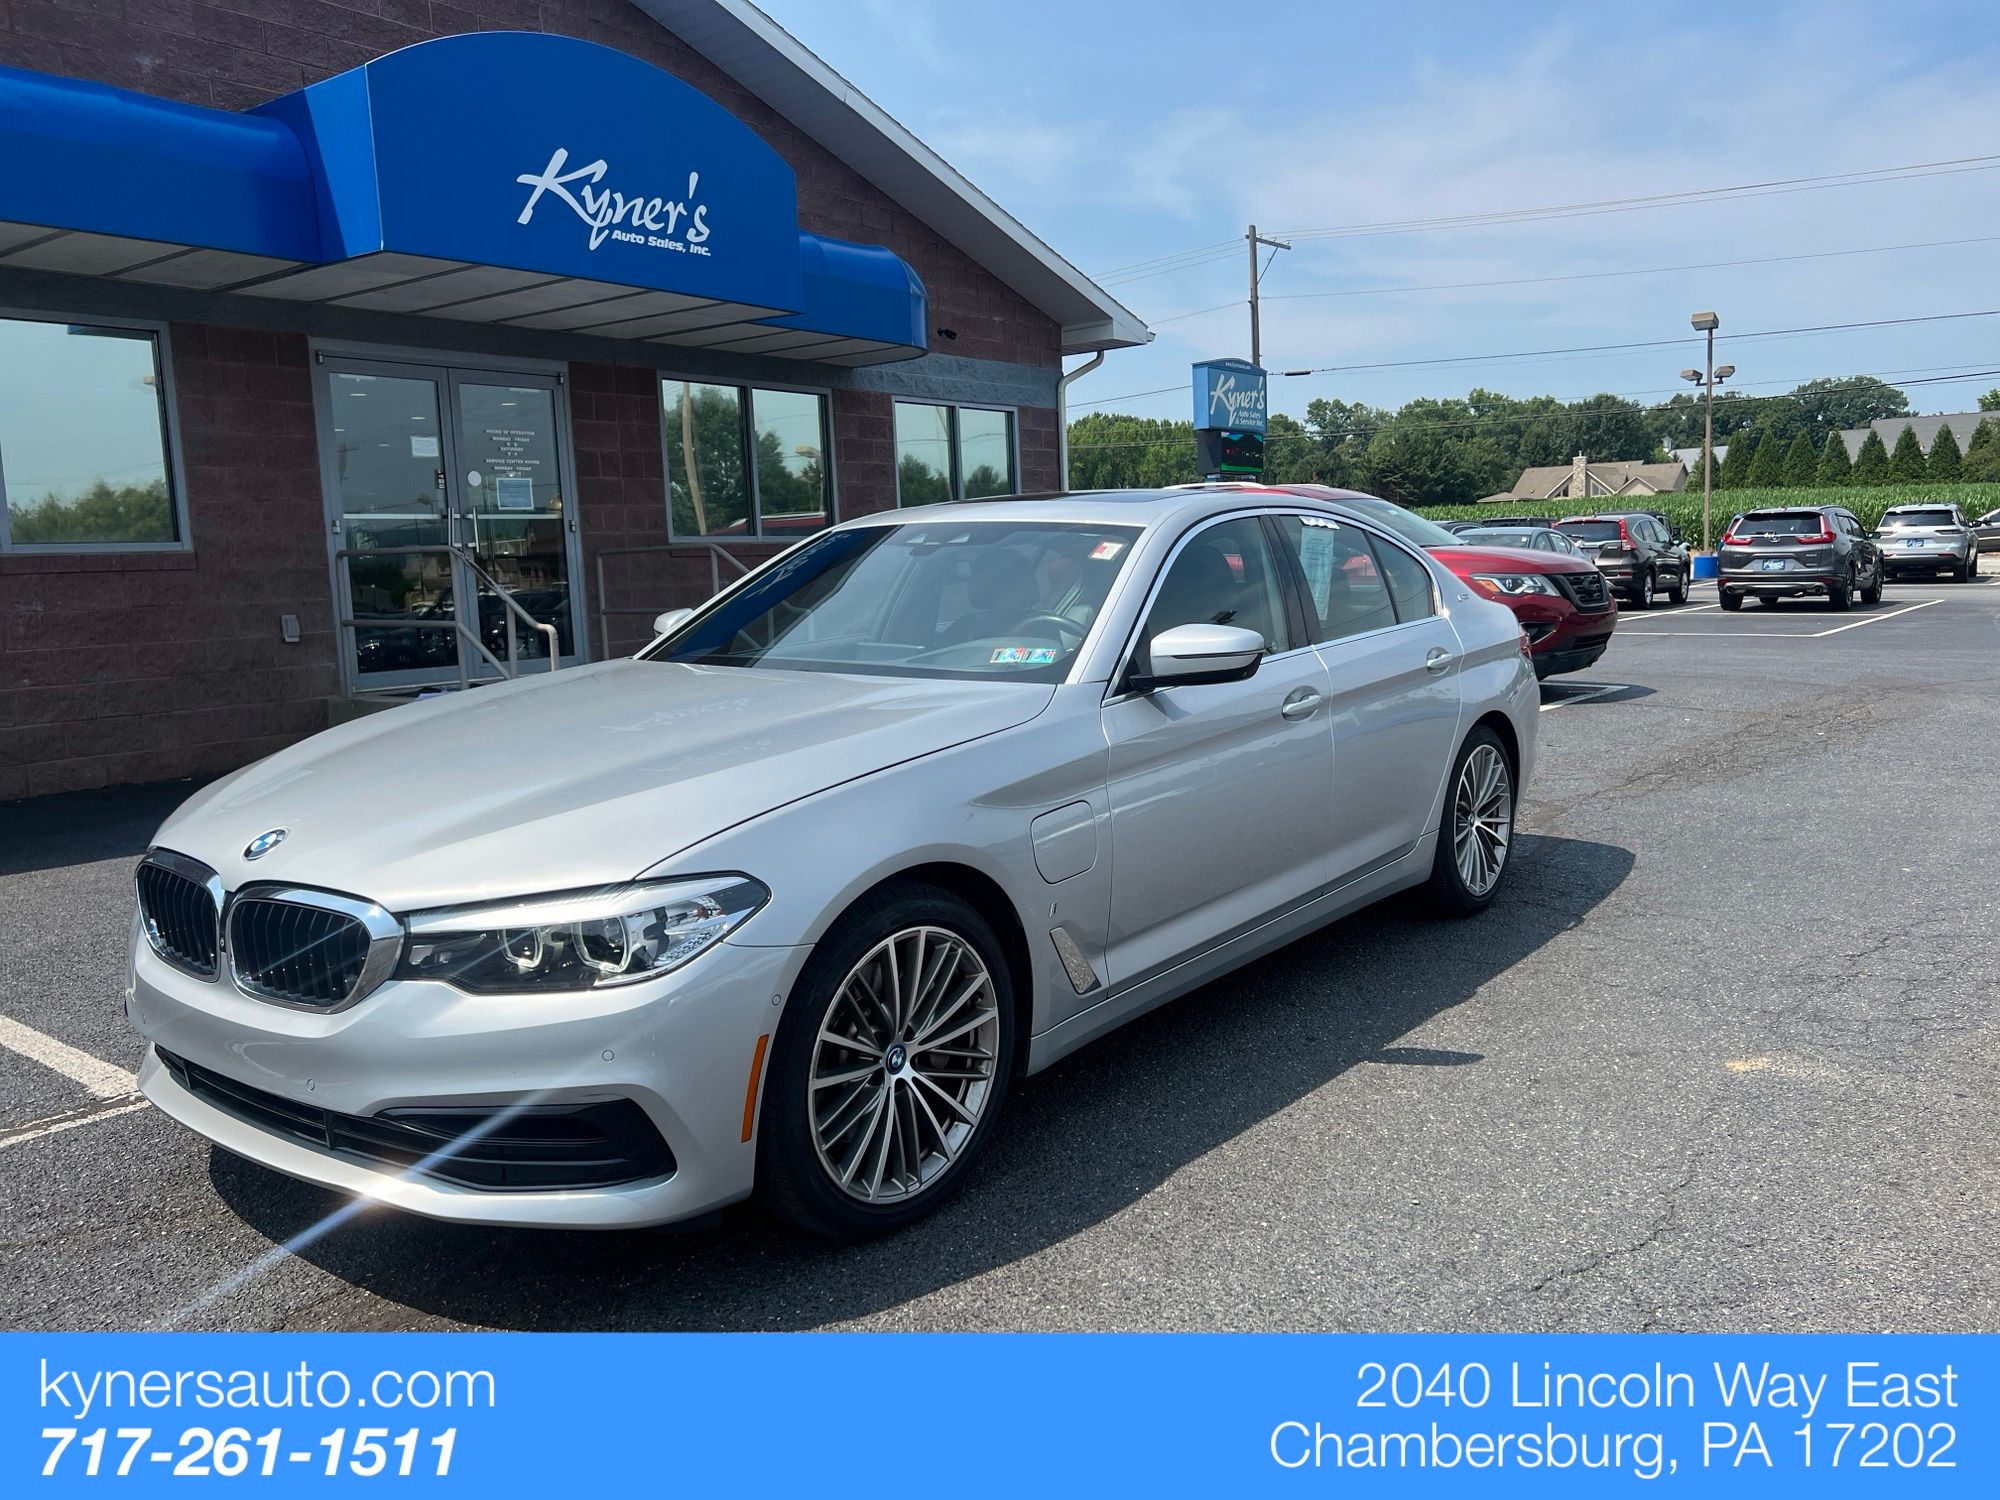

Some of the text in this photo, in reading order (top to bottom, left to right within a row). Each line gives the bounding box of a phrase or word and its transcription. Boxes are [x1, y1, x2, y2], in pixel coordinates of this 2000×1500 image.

[516, 148, 710, 250] Kyner's
[611, 229, 711, 257] Auto Sales, Inc.
[1209, 374, 1265, 427] Kyner's
